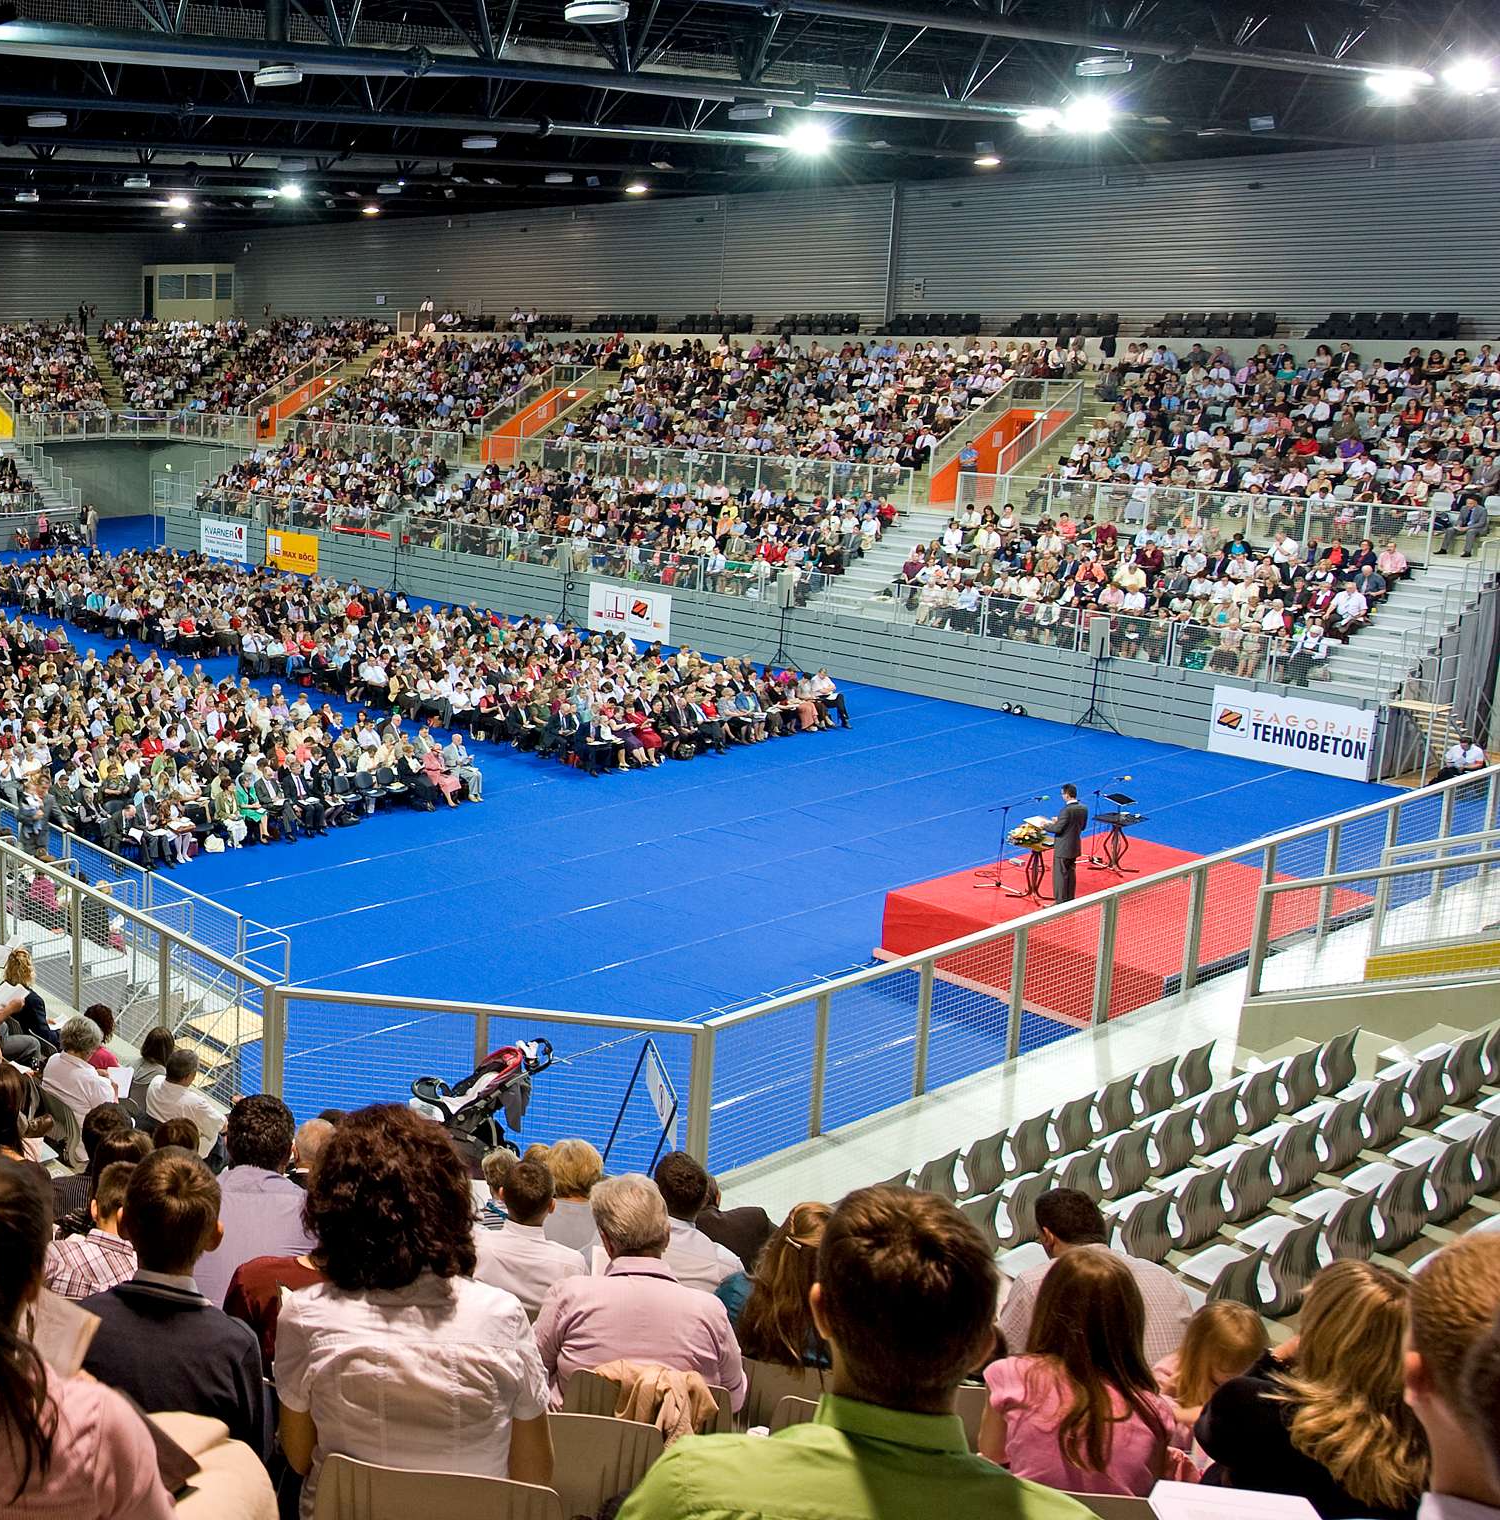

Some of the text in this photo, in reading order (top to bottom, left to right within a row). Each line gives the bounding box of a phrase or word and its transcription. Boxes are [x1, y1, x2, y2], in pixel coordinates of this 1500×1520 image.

[204, 525, 233, 538] KVARNER
[283, 550, 297, 559] MAX
[1253, 709, 1368, 739] ZAGORJE
[1253, 722, 1366, 760] TEHNOBETON
